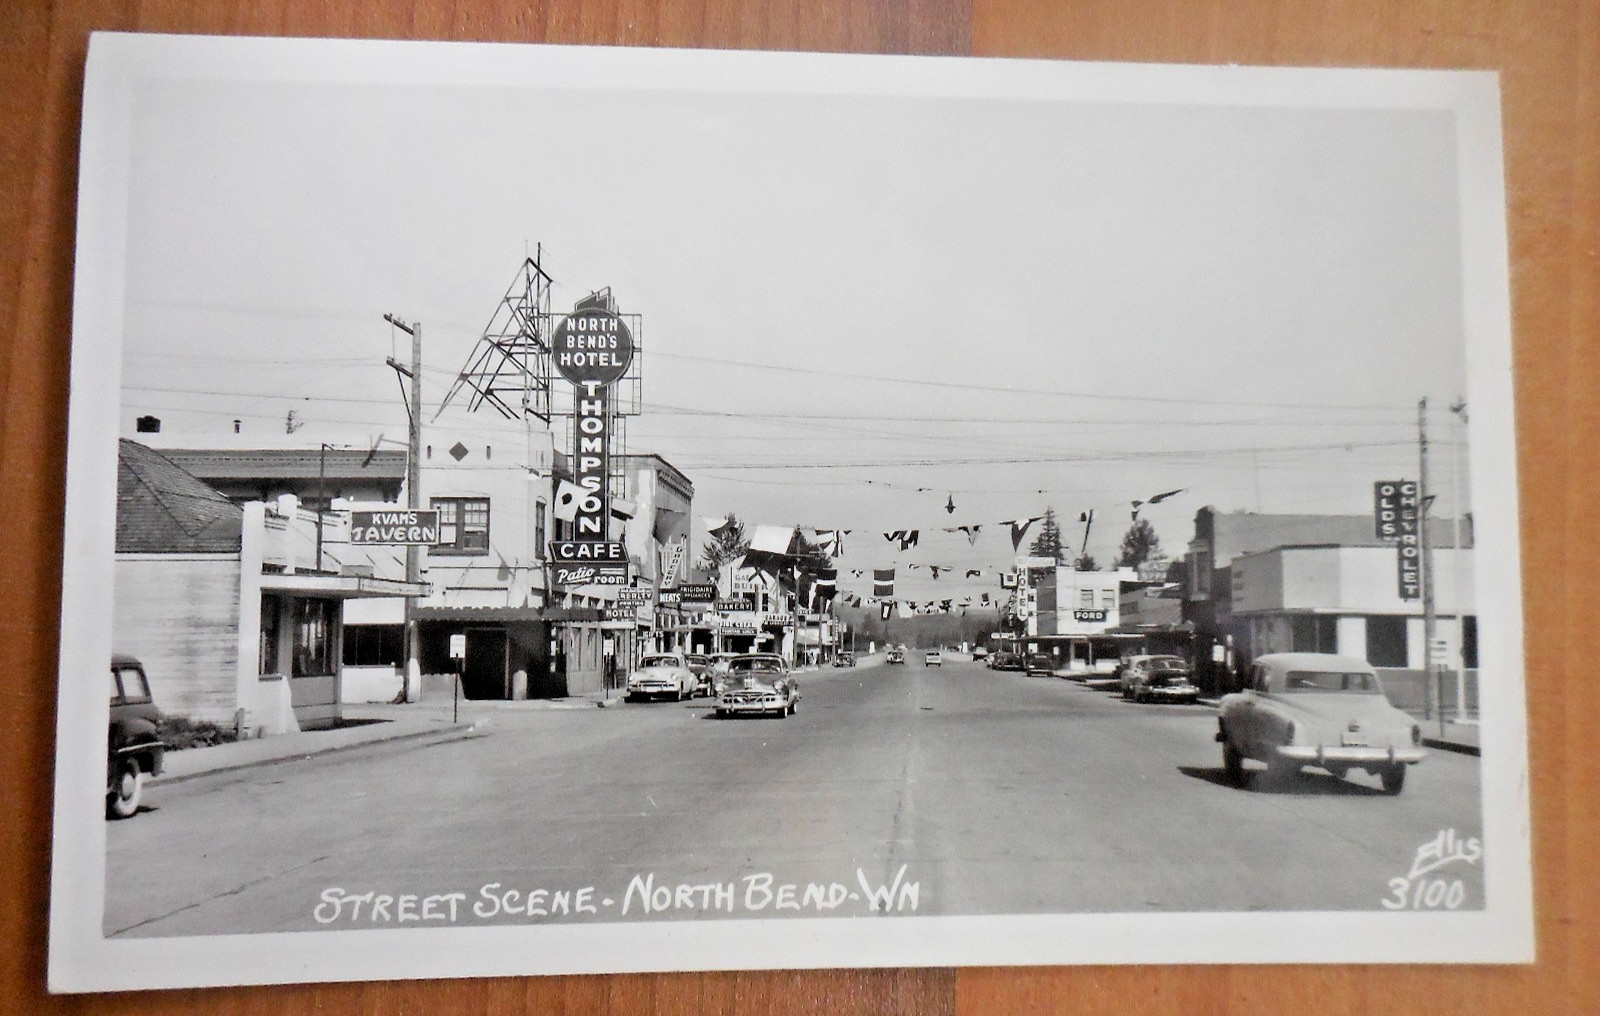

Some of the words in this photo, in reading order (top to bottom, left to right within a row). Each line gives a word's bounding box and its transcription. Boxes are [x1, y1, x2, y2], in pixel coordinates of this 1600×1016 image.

[566, 317, 618, 332] NORTH
[566, 333, 618, 349] BEND'S
[560, 352, 623, 367] HOTEL
[580, 380, 604, 534] THOMPSON
[1381, 485, 1395, 535] OLDS
[351, 526, 436, 542] TAVERN
[1401, 484, 1418, 596] CHEVROLET
[560, 543, 621, 559] CAFE
[557, 567, 596, 584] Patio
[594, 575, 625, 585] room
[660, 592, 680, 603] MEATS
[1018, 567, 1027, 617] HOTEL
[605, 609, 635, 618] HOTEL
[1075, 609, 1103, 620] FORD
